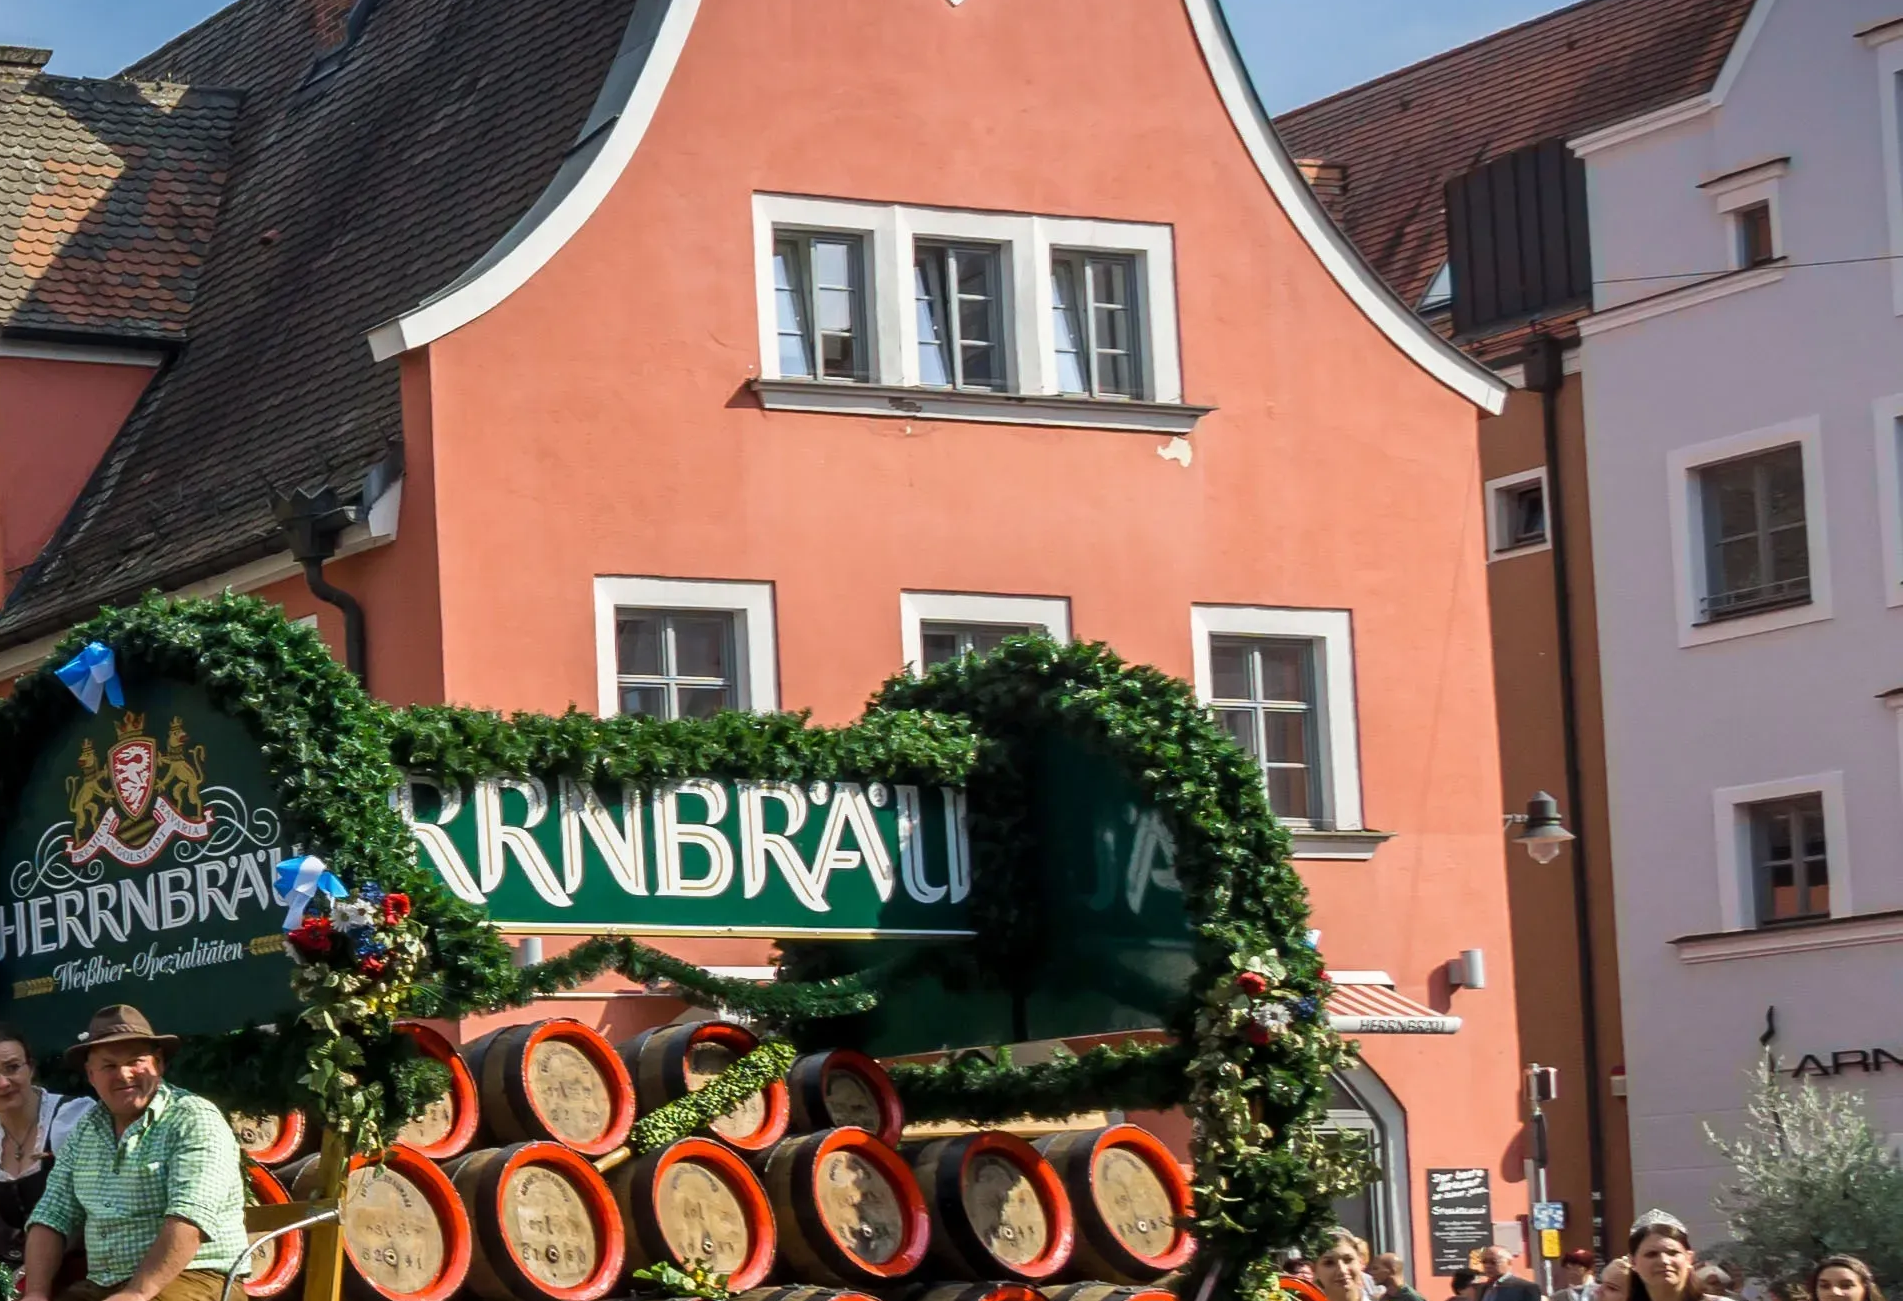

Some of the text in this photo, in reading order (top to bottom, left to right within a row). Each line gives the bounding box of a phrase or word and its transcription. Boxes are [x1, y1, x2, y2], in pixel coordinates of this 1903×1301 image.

[104, 832, 167, 861] INGOLSTADT
[159, 801, 200, 835] BAVARIA
[389, 774, 971, 912] RRNBRÄU
[52, 937, 243, 992] Weißbier-Spezialitäten
